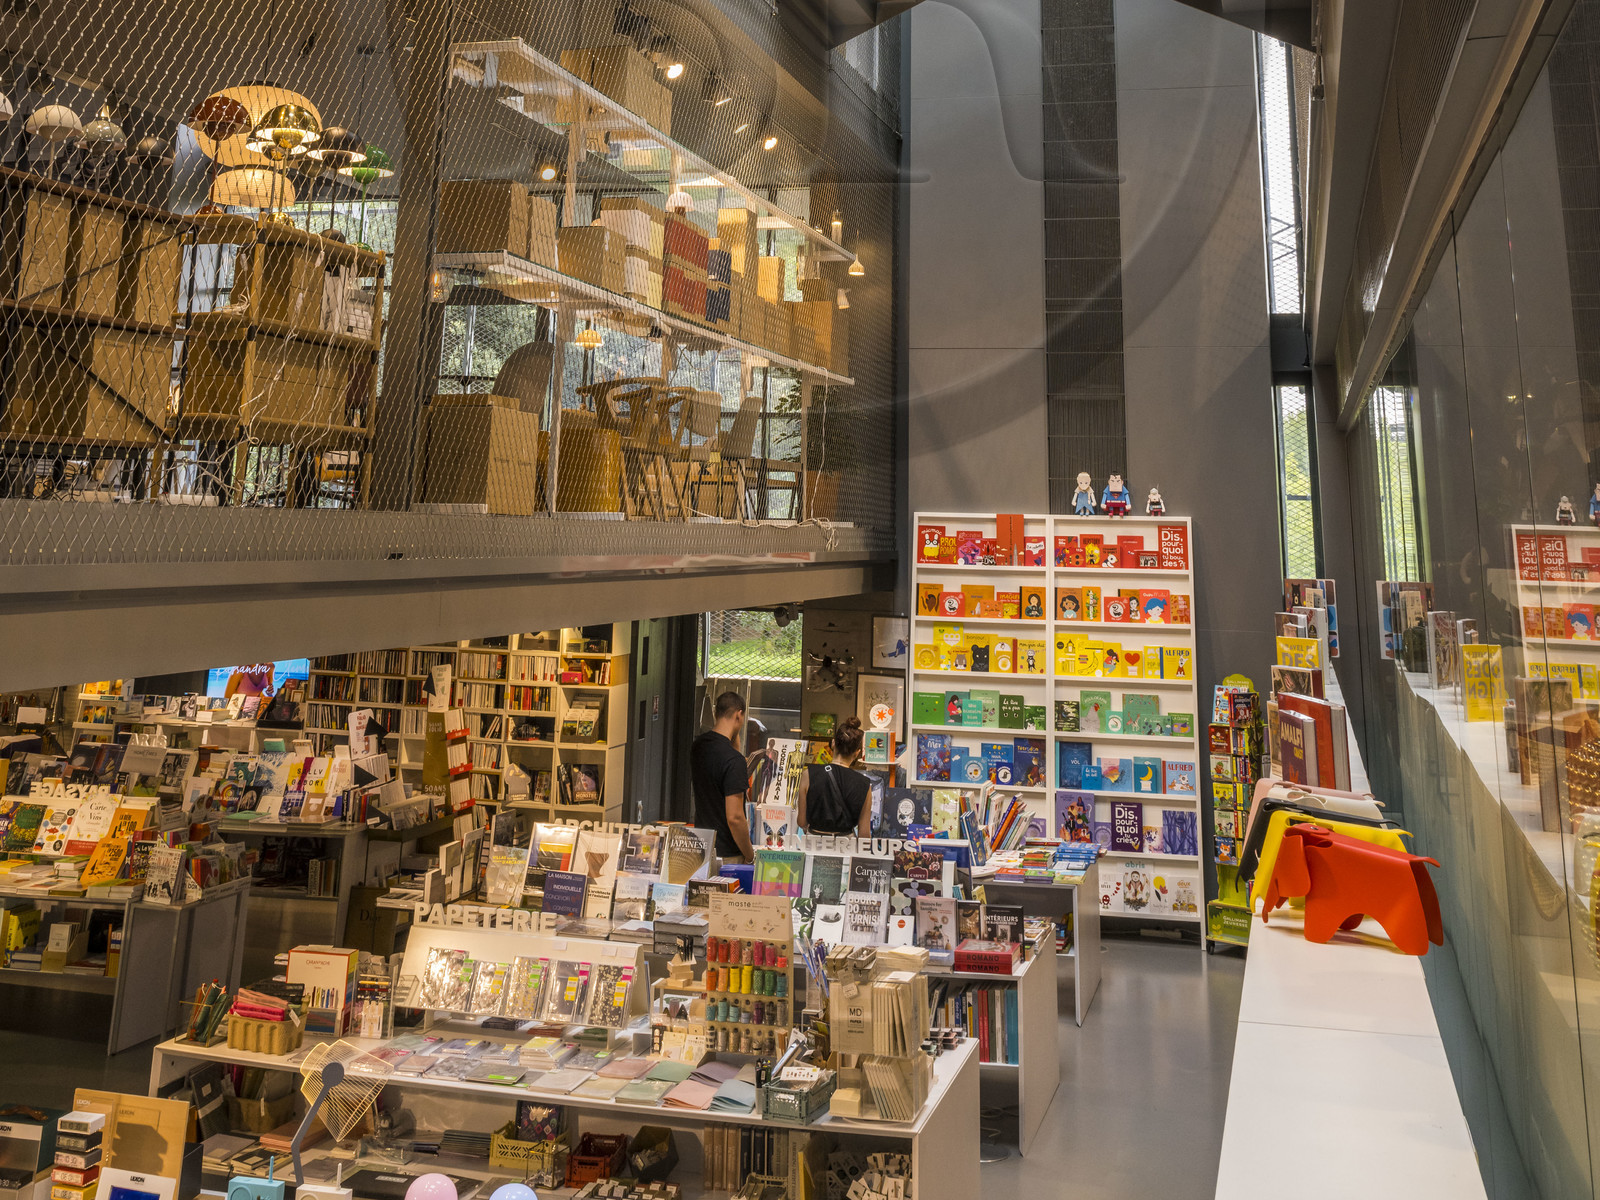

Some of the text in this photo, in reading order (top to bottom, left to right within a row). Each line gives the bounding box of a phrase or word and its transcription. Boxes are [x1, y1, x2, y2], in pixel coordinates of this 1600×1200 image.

[1161, 531, 1183, 542] Dis,
[1162, 547, 1184, 555] quoi
[1165, 649, 1190, 657] ALFRED
[130, 733, 168, 749] ARTS
[1167, 763, 1193, 772] ALFRED
[1115, 808, 1138, 820] Dis,
[1116, 826, 1138, 835] quoi
[671, 840, 708, 850] JAPANESE
[1125, 861, 1145, 869] abris
[855, 865, 887, 878] Carpets
[848, 893, 878, 905] BOOKS
[848, 904, 860, 913] DO
[413, 902, 558, 933] PAPETERIE
[967, 954, 1000, 962] ROMANO
[967, 964, 1000, 972] ROMANO
[849, 1008, 862, 1016] MD
[130, 1175, 145, 1183] LEXON
